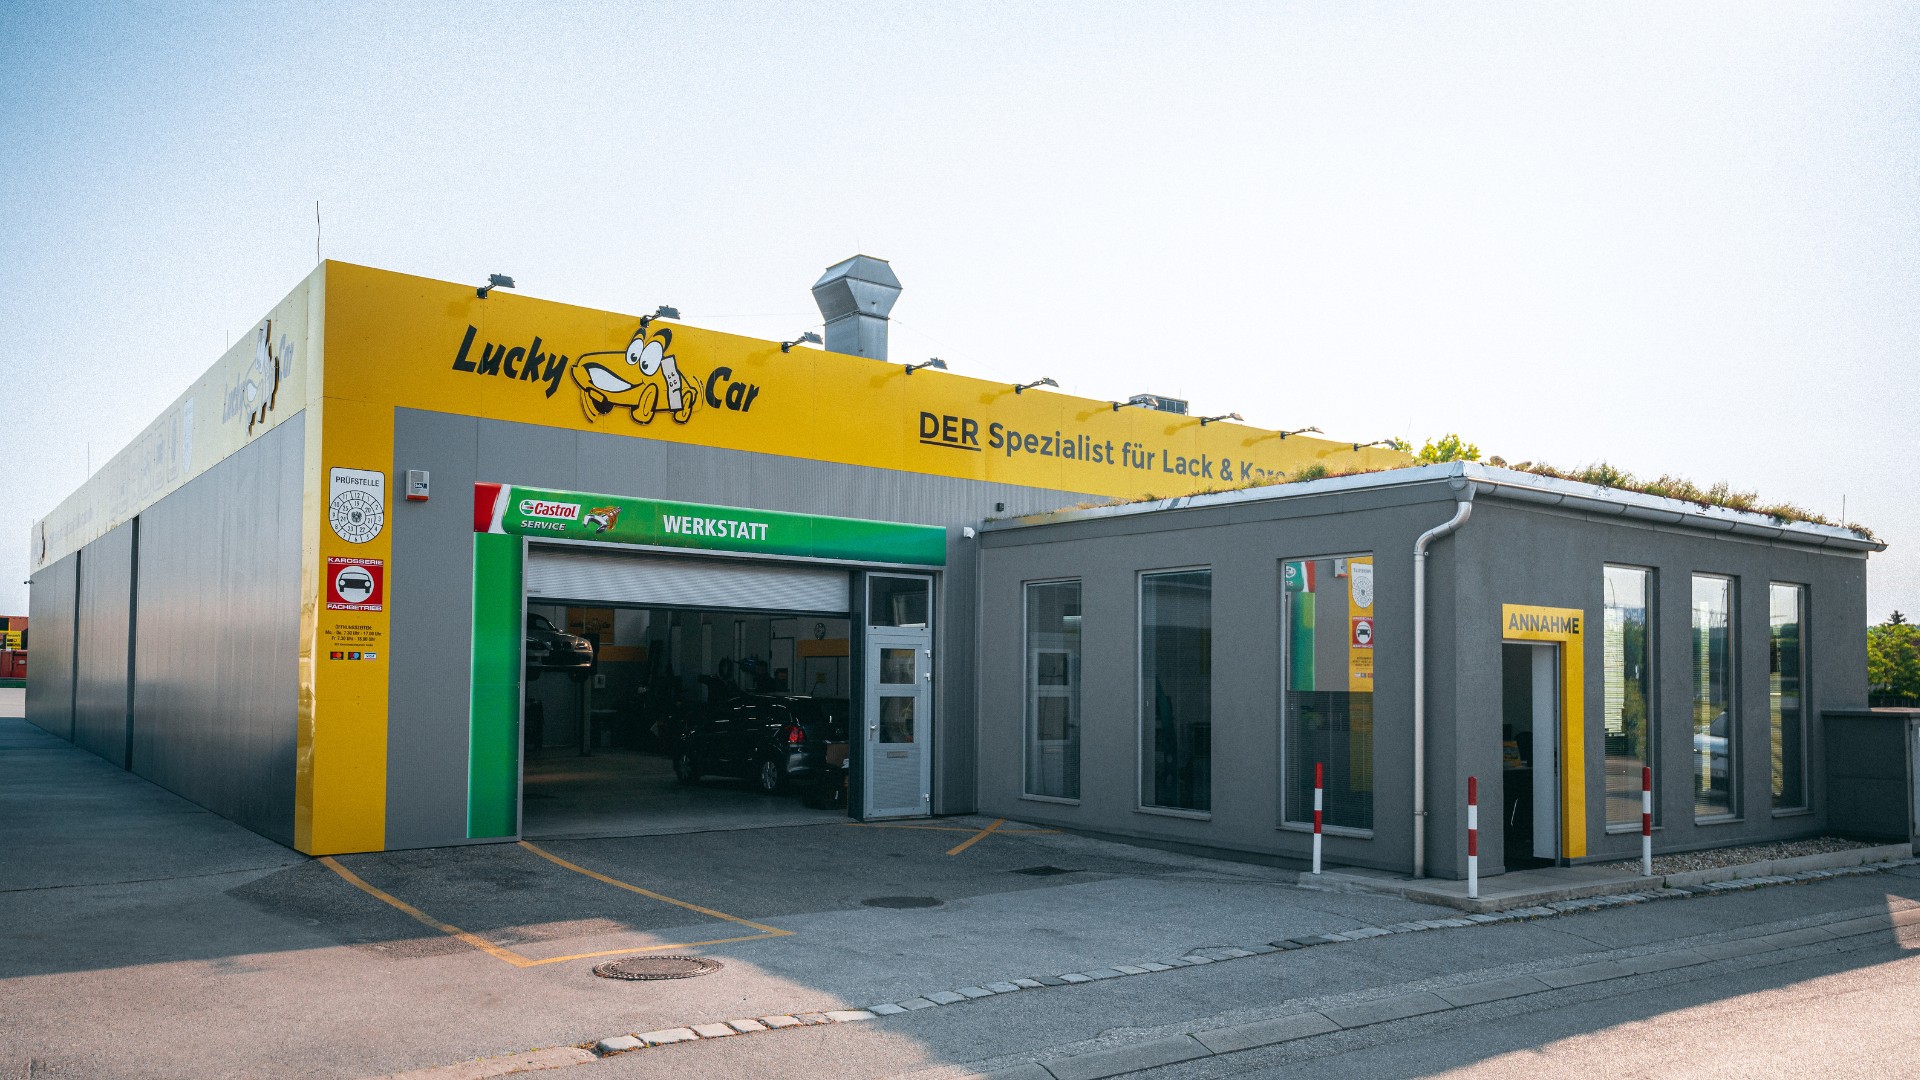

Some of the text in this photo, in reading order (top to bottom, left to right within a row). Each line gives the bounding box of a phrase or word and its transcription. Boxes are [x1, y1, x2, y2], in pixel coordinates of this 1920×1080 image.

[452, 324, 760, 412] Lucky Car
[919, 411, 980, 447] DER
[988, 422, 1115, 465] Spezialist
[1122, 441, 1155, 470] für
[1163, 449, 1213, 479] Lack
[1219, 458, 1234, 481] &
[335, 476, 380, 487] PRÜFSTELLE
[534, 502, 577, 518] Castrol
[520, 520, 566, 531] SERVICE
[663, 514, 768, 540] WERKSTATT
[328, 557, 383, 566] KAROSSERIE
[1508, 613, 1580, 634] ANNAHME
